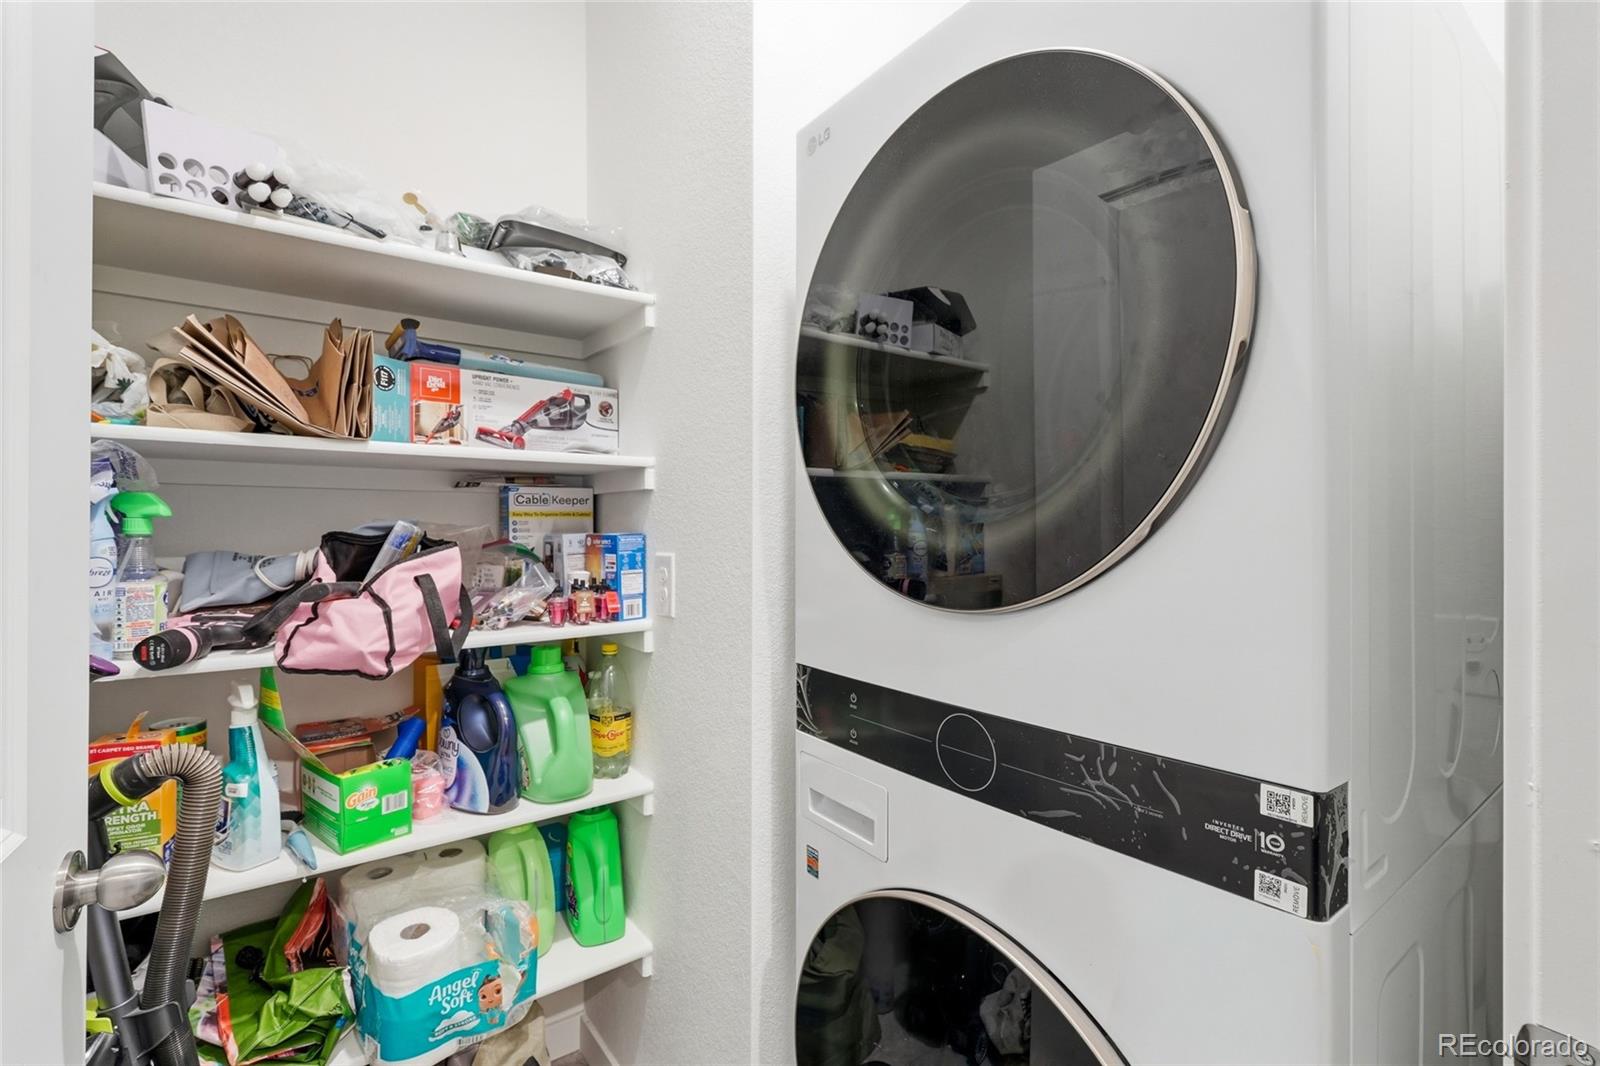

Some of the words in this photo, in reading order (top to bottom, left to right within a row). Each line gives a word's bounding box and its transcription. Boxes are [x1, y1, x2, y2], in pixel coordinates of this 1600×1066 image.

[515, 494, 549, 505] Cable
[551, 495, 590, 507] Keeper
[94, 590, 112, 598] AIR
[346, 787, 377, 808] Gain
[1204, 822, 1229, 836] DIRECT
[1230, 829, 1253, 842] DRIVE
[1212, 819, 1245, 832] INVERTER
[1219, 834, 1237, 843] MOTOR
[1259, 831, 1286, 853] 10
[1292, 886, 1300, 912] REMOVE
[428, 971, 480, 1006] Angel
[440, 988, 474, 1015] Soft
